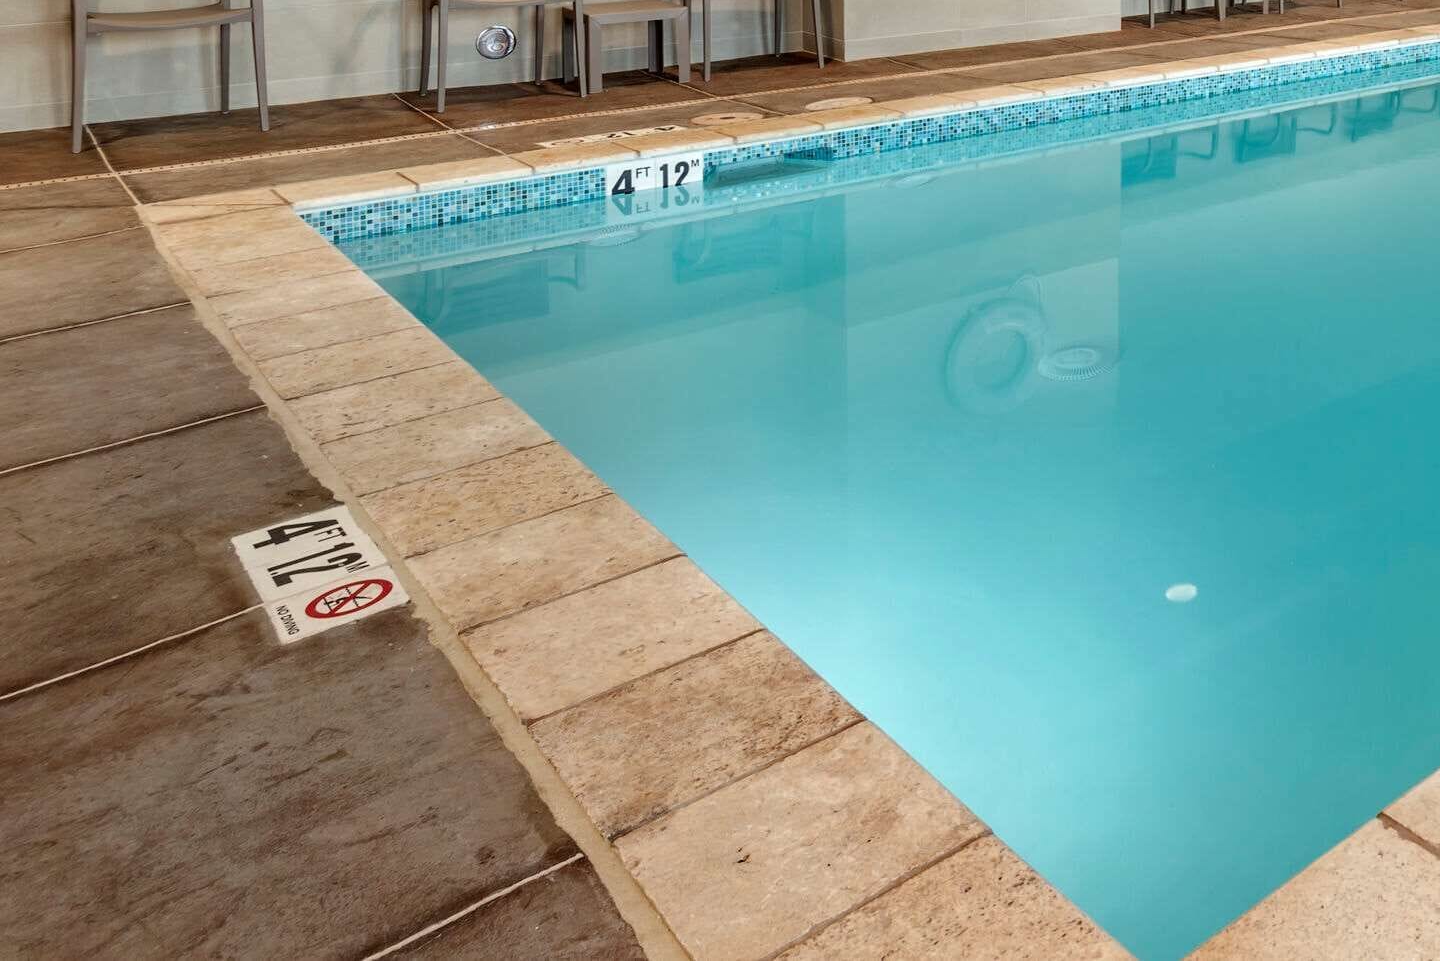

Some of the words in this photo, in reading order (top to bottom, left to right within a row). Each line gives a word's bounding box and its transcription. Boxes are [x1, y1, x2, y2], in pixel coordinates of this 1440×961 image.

[612, 169, 635, 195] 4
[636, 166, 651, 178] FT
[691, 159, 700, 167] M
[252, 519, 339, 549] 4
[313, 526, 347, 543] FT
[344, 560, 370, 573] M
[280, 613, 300, 636] DIVING
